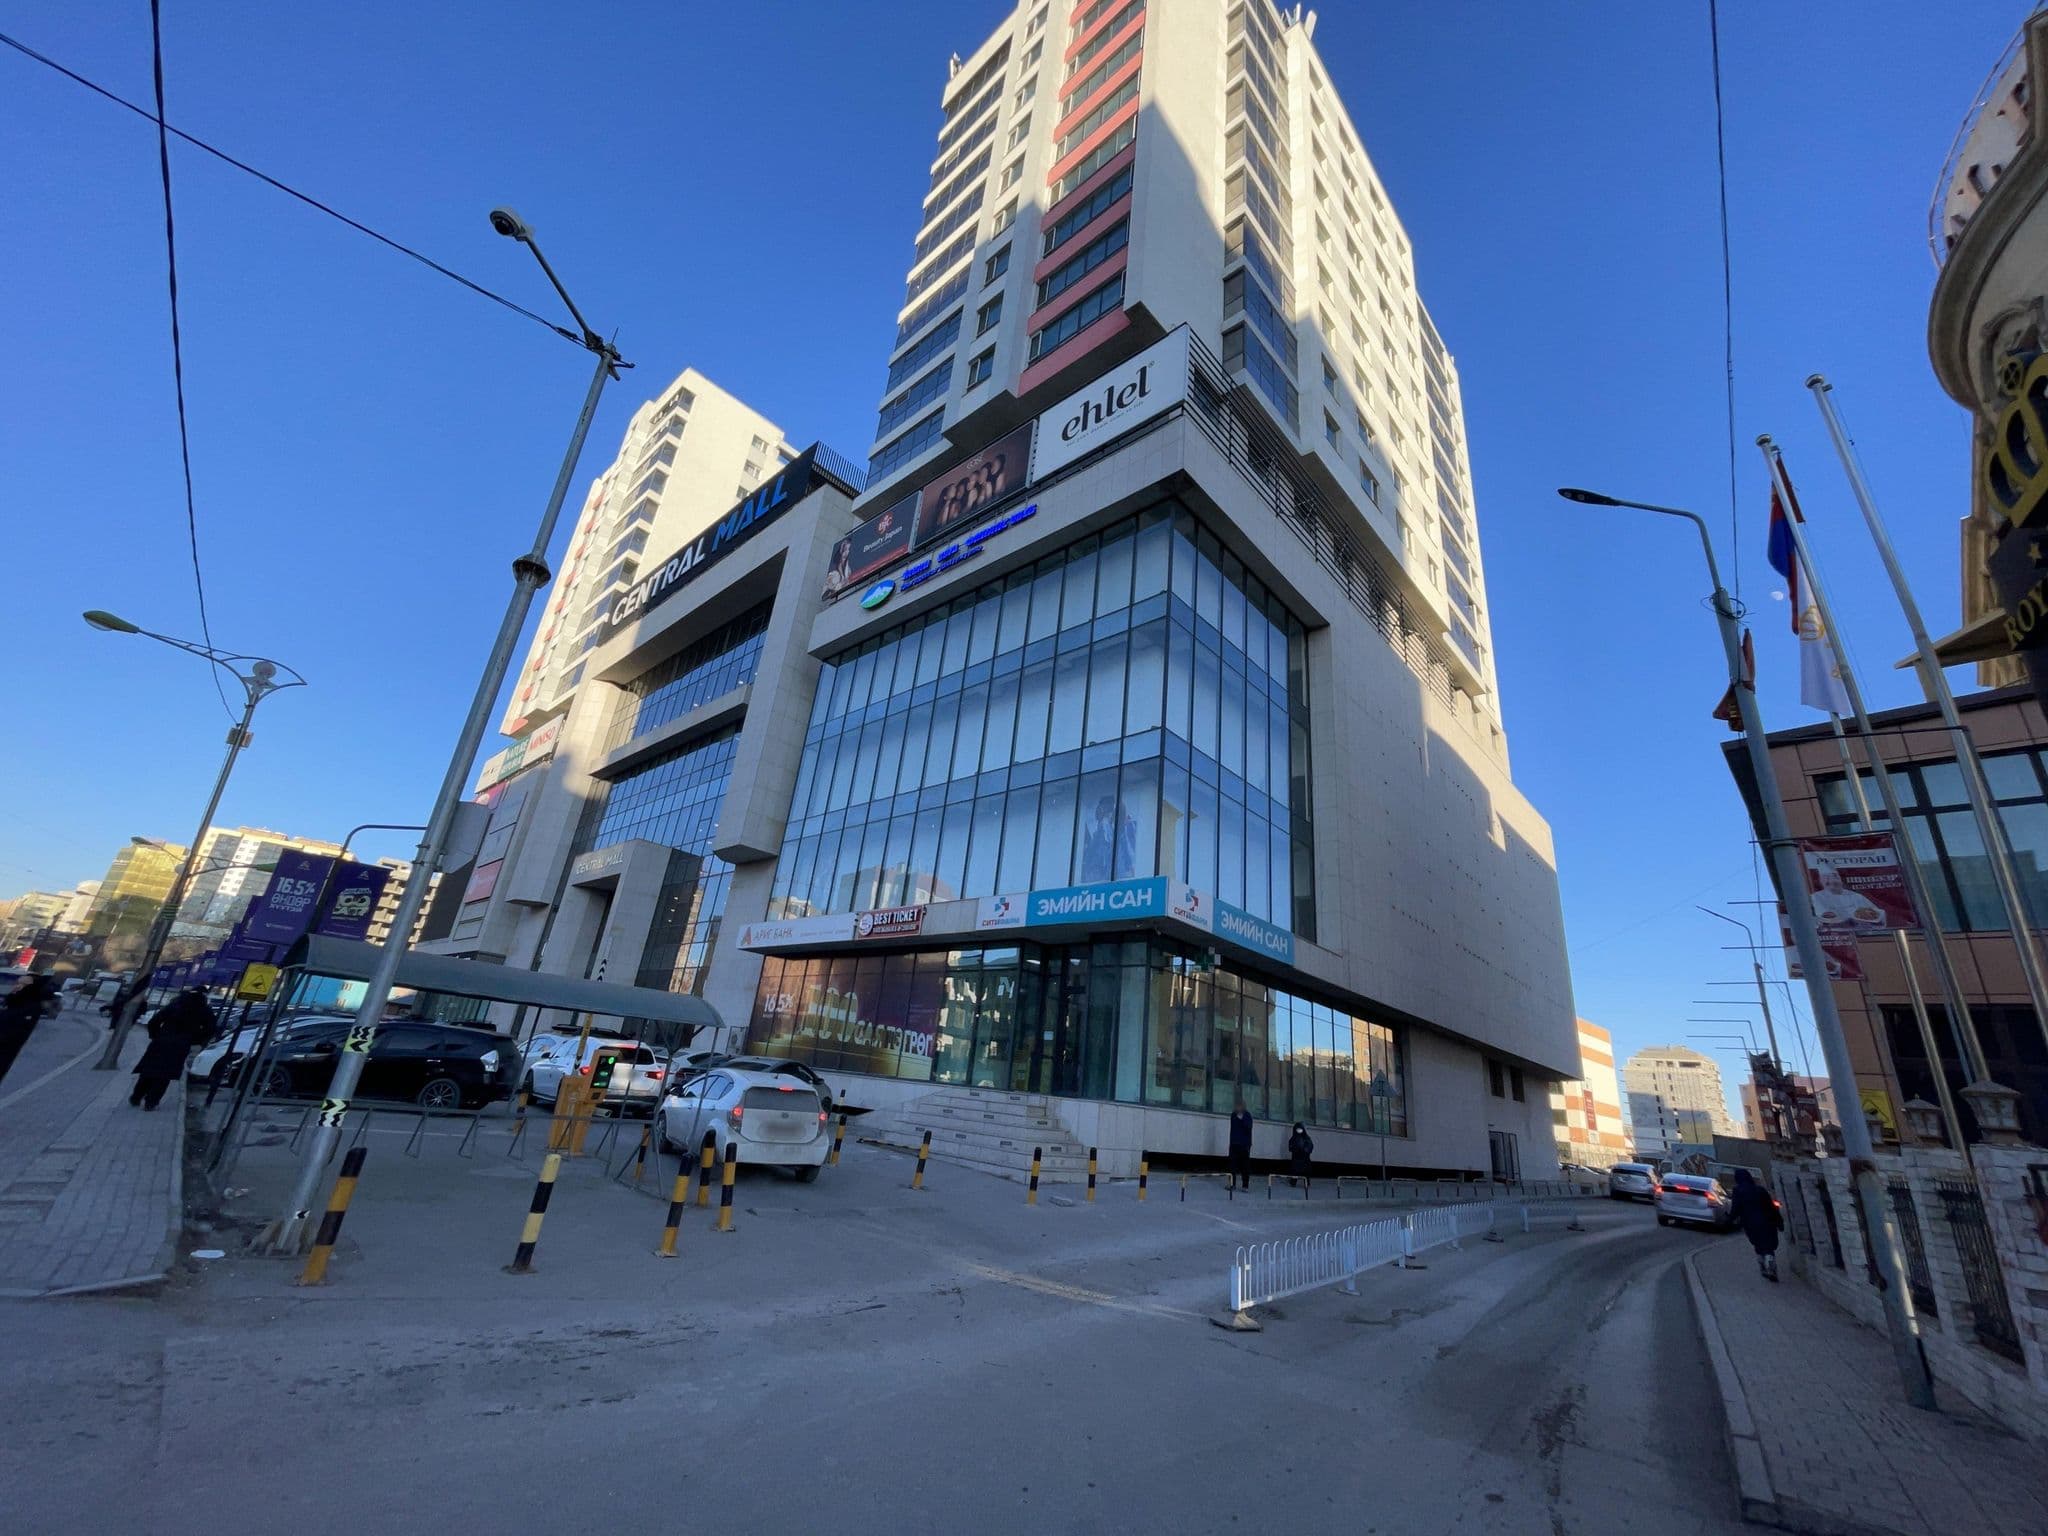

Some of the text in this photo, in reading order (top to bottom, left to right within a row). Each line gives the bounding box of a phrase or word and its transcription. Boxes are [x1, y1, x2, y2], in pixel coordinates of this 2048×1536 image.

[1061, 365, 1151, 441] ehlel
[611, 475, 787, 626] CENTRAL MALL
[276, 877, 316, 896] 16.5%
[1037, 887, 1153, 916] ЭМИЙН САН
[874, 909, 919, 925] BEST TICKET
[1221, 910, 1288, 954] ЭМИЙН САН
